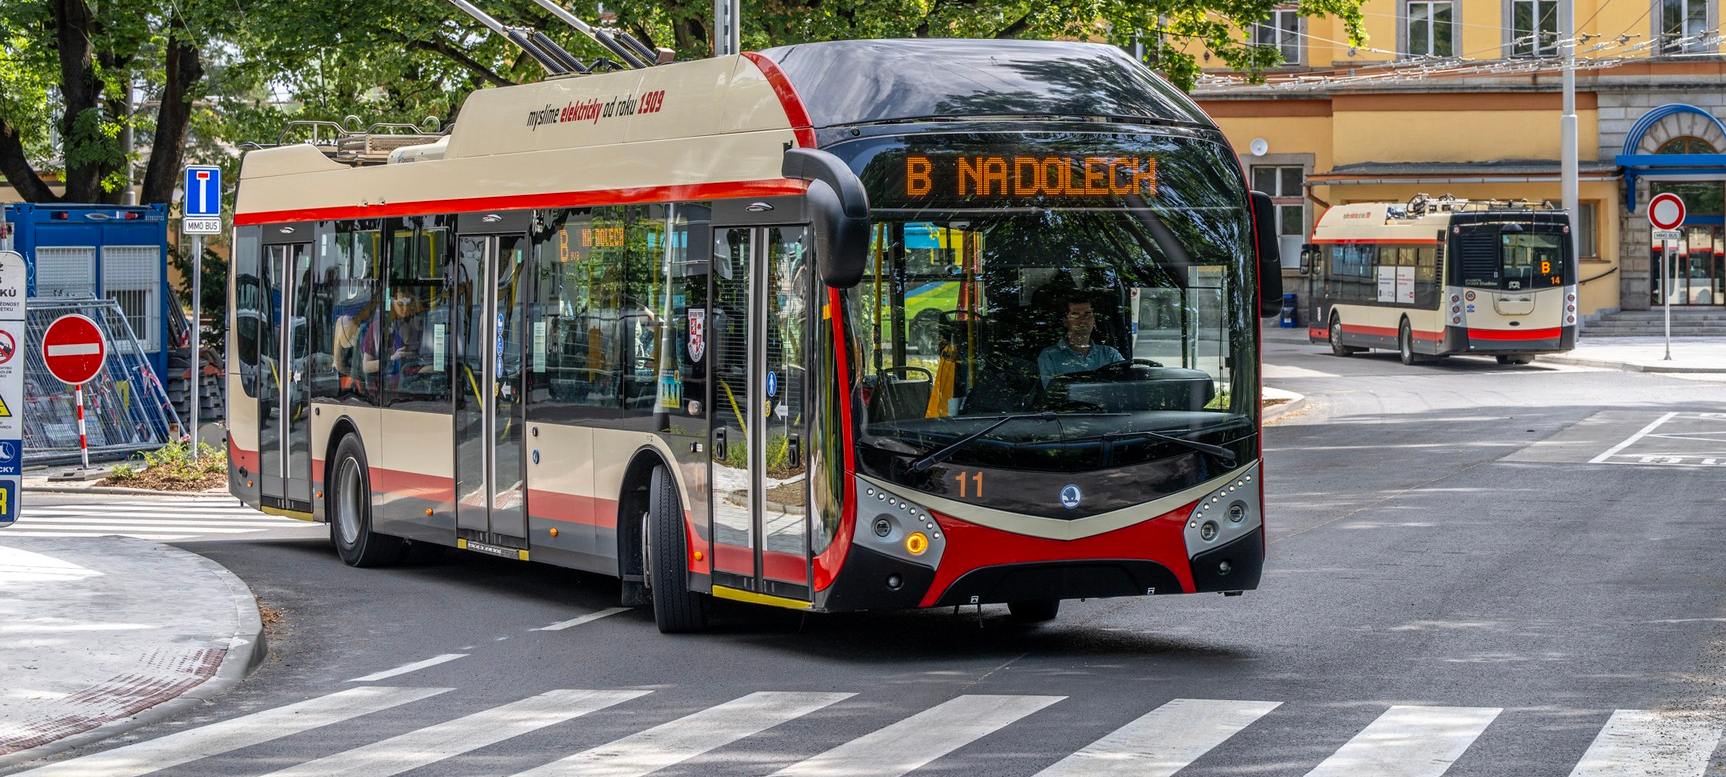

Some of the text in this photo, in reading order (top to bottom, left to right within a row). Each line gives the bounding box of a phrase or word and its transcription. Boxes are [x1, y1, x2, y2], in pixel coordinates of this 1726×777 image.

[560, 98, 604, 125] elektricky
[603, 96, 617, 117] od
[615, 94, 637, 116] roku
[638, 90, 664, 114] 1909
[907, 157, 1157, 196] B NA DOLECH
[560, 229, 569, 263] B
[1541, 261, 1551, 274] B
[1551, 276, 1561, 285] 14
[955, 471, 983, 498] 11
